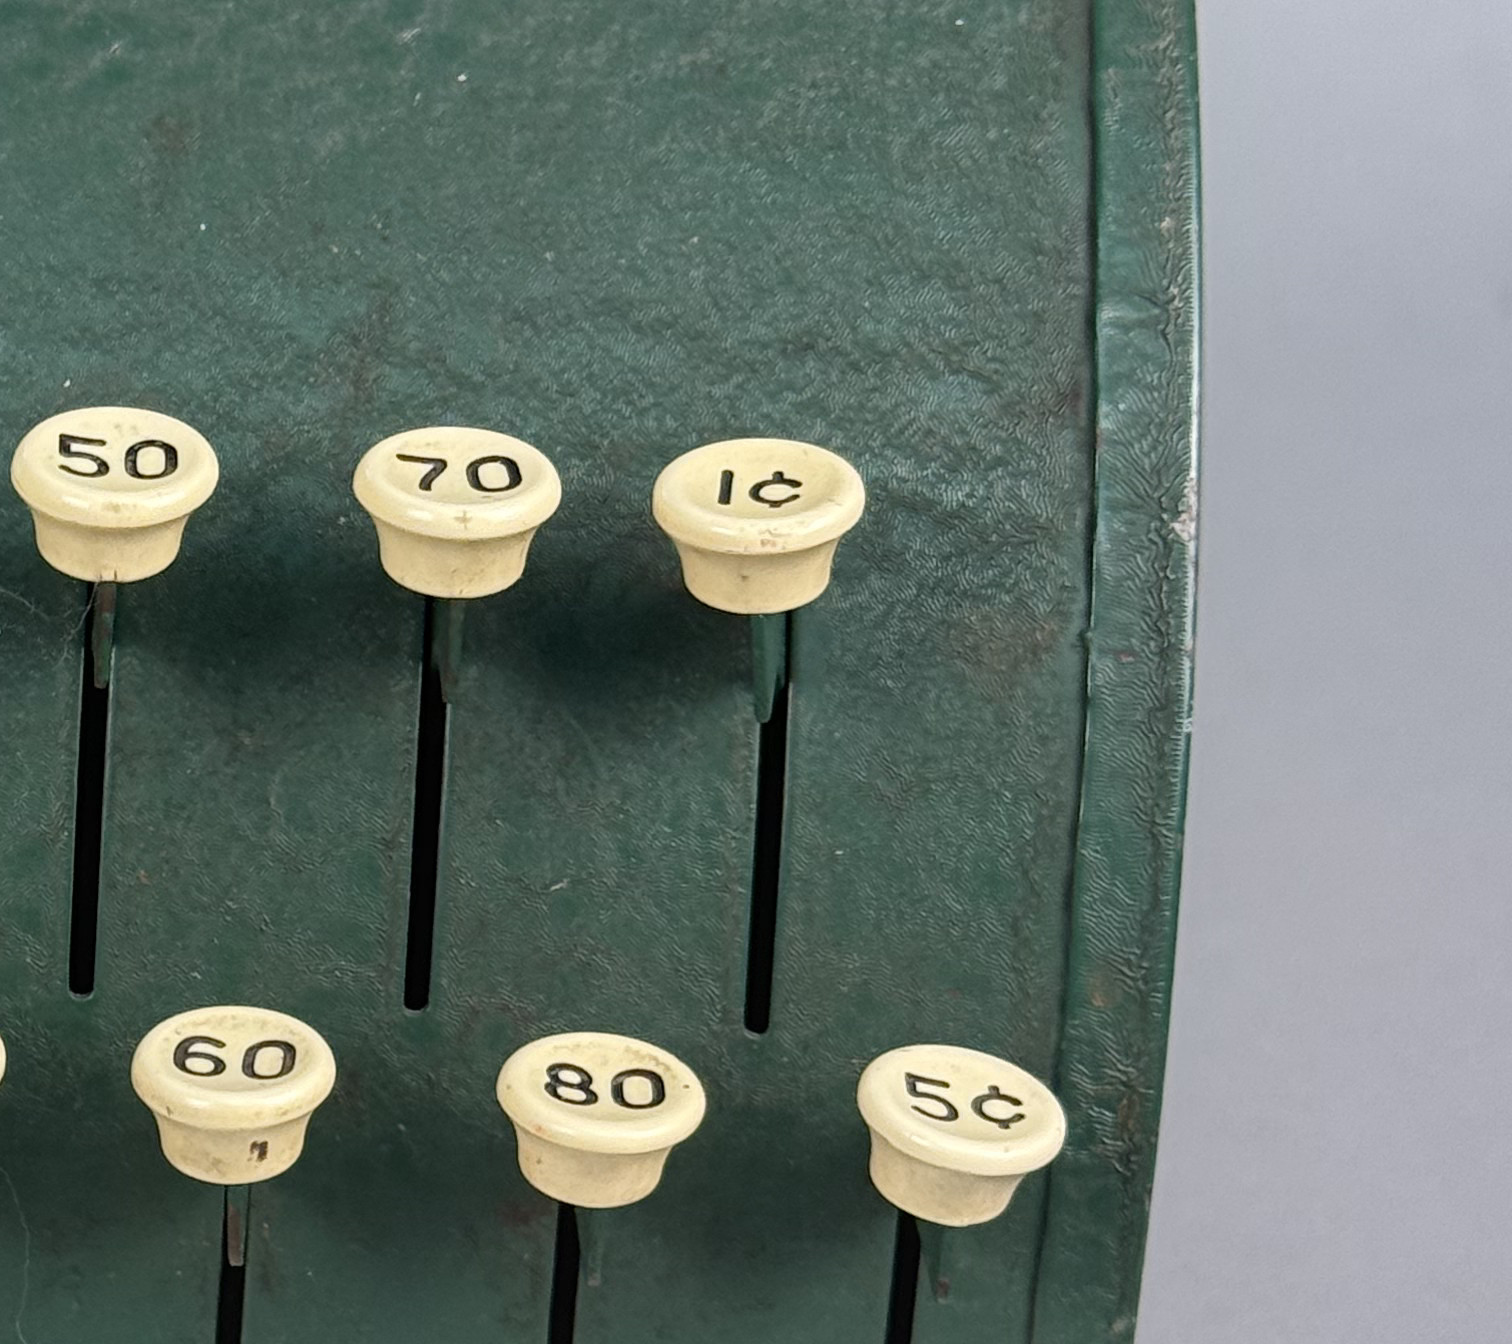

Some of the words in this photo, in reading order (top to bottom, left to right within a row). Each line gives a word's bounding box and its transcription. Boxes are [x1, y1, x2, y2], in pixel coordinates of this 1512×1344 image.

[57, 433, 179, 481] 50
[395, 453, 523, 495] 70
[716, 469, 804, 510] 1¢
[171, 1035, 296, 1081] 60
[543, 1061, 667, 1110] 80
[904, 1071, 1026, 1130] 5¢
